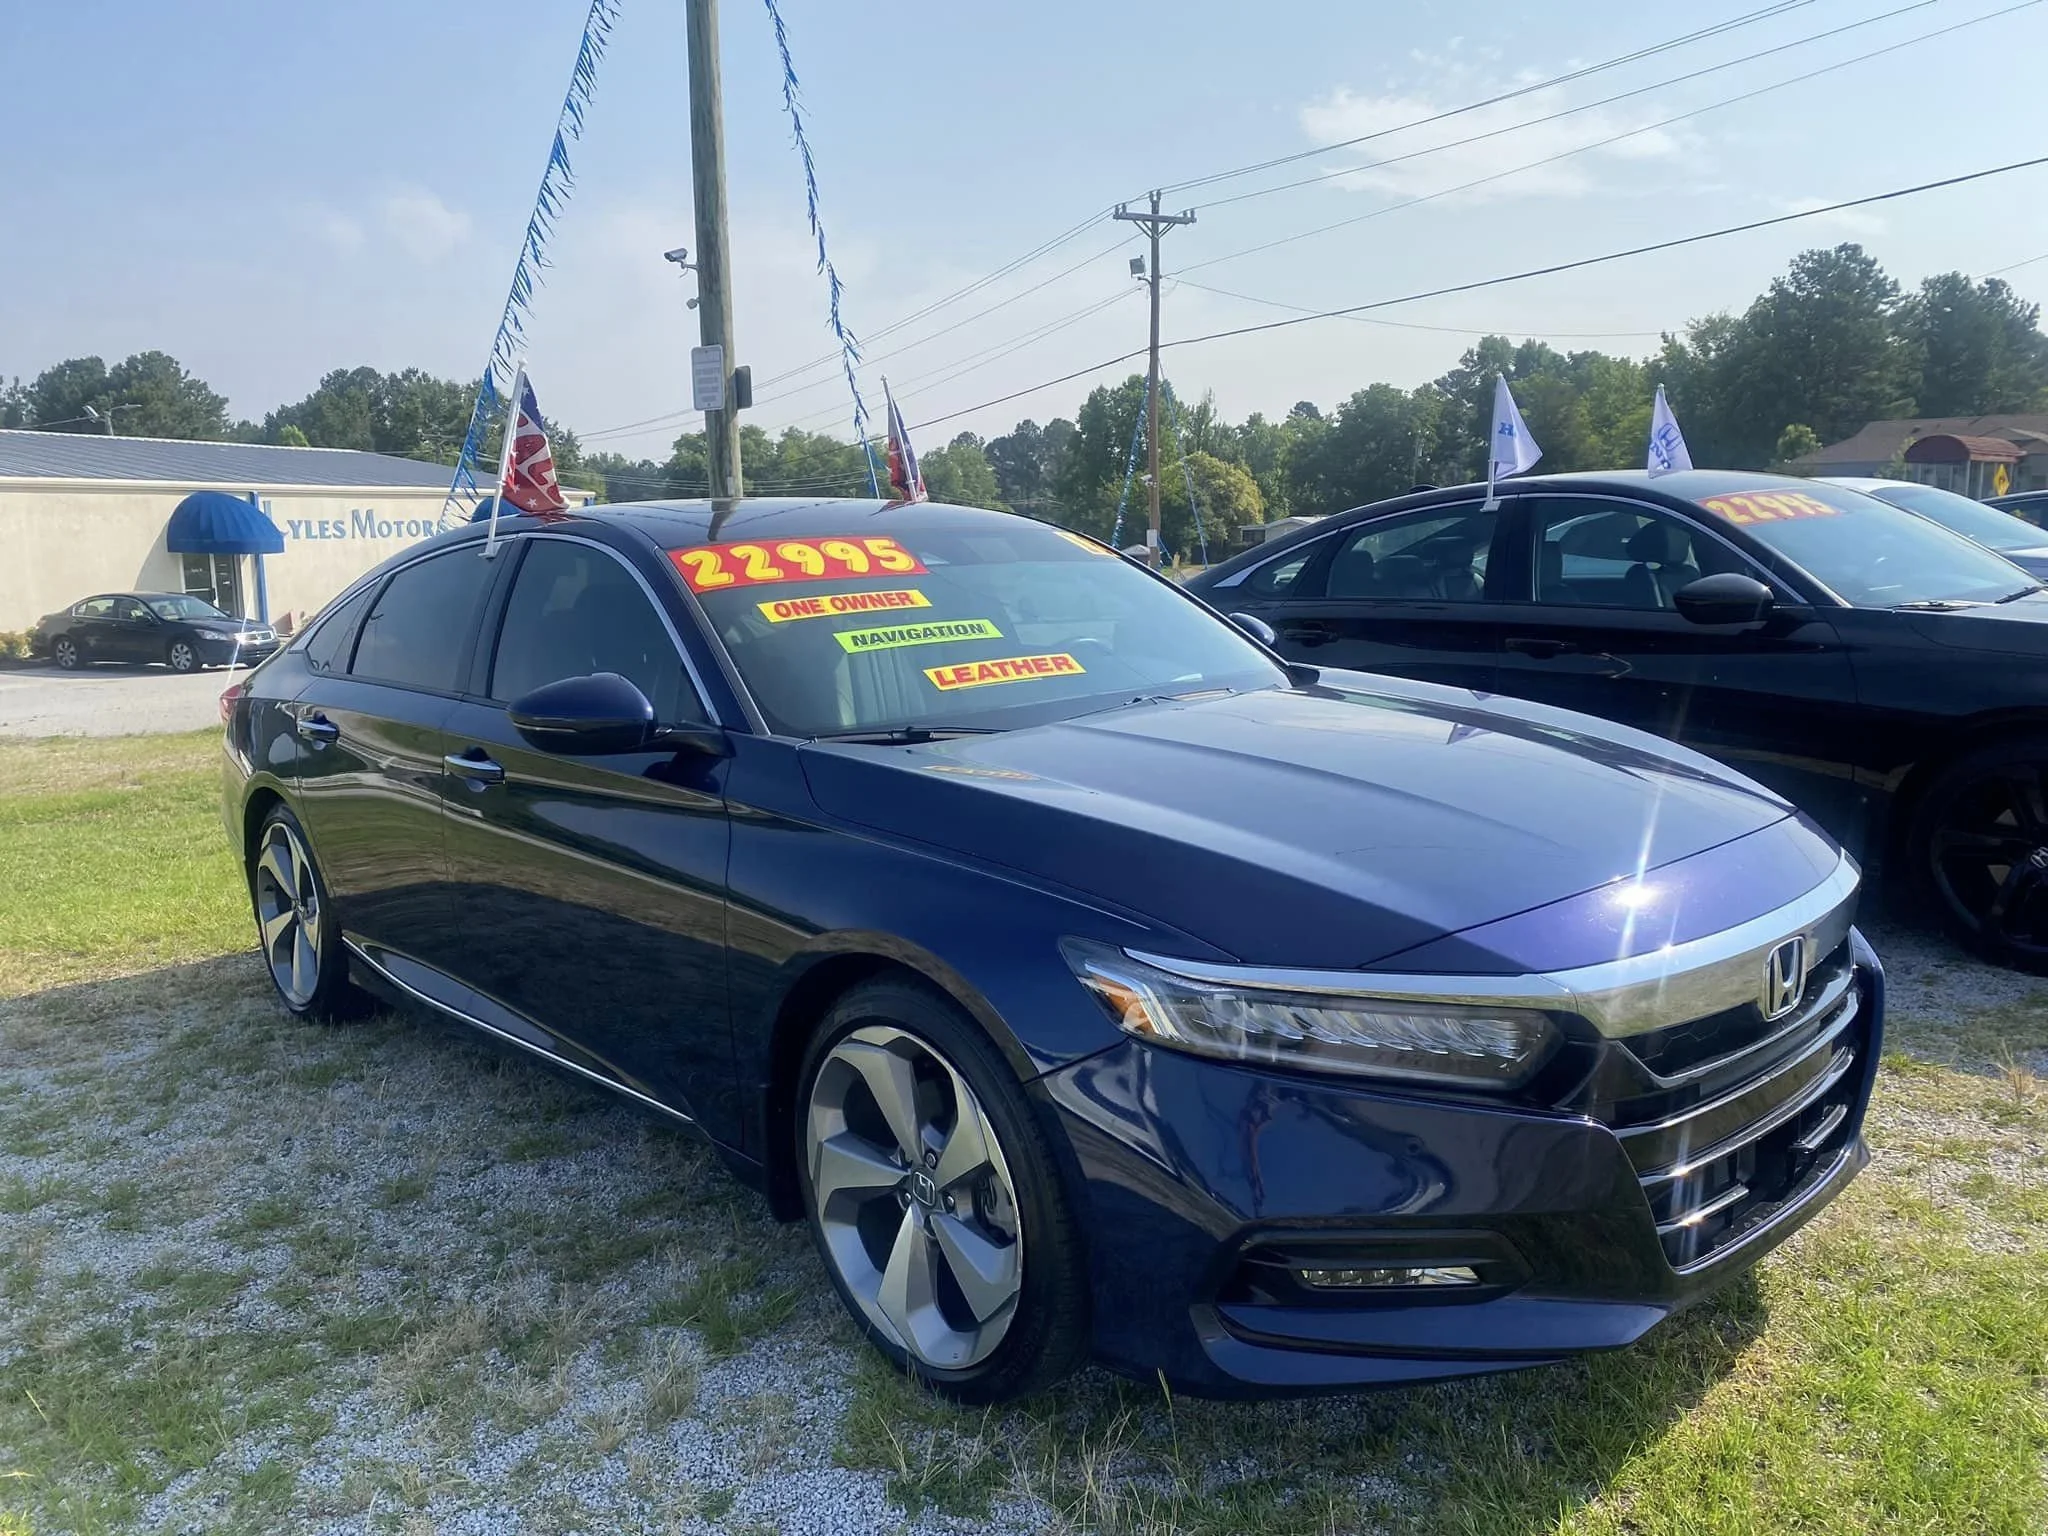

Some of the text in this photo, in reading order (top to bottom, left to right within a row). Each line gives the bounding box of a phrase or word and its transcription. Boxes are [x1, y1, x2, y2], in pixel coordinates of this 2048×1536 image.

[680, 539, 915, 587] 22995
[773, 591, 915, 618] ONE OWNER
[850, 623, 988, 648] NAVIGATION
[934, 656, 1075, 686] LEATHER
